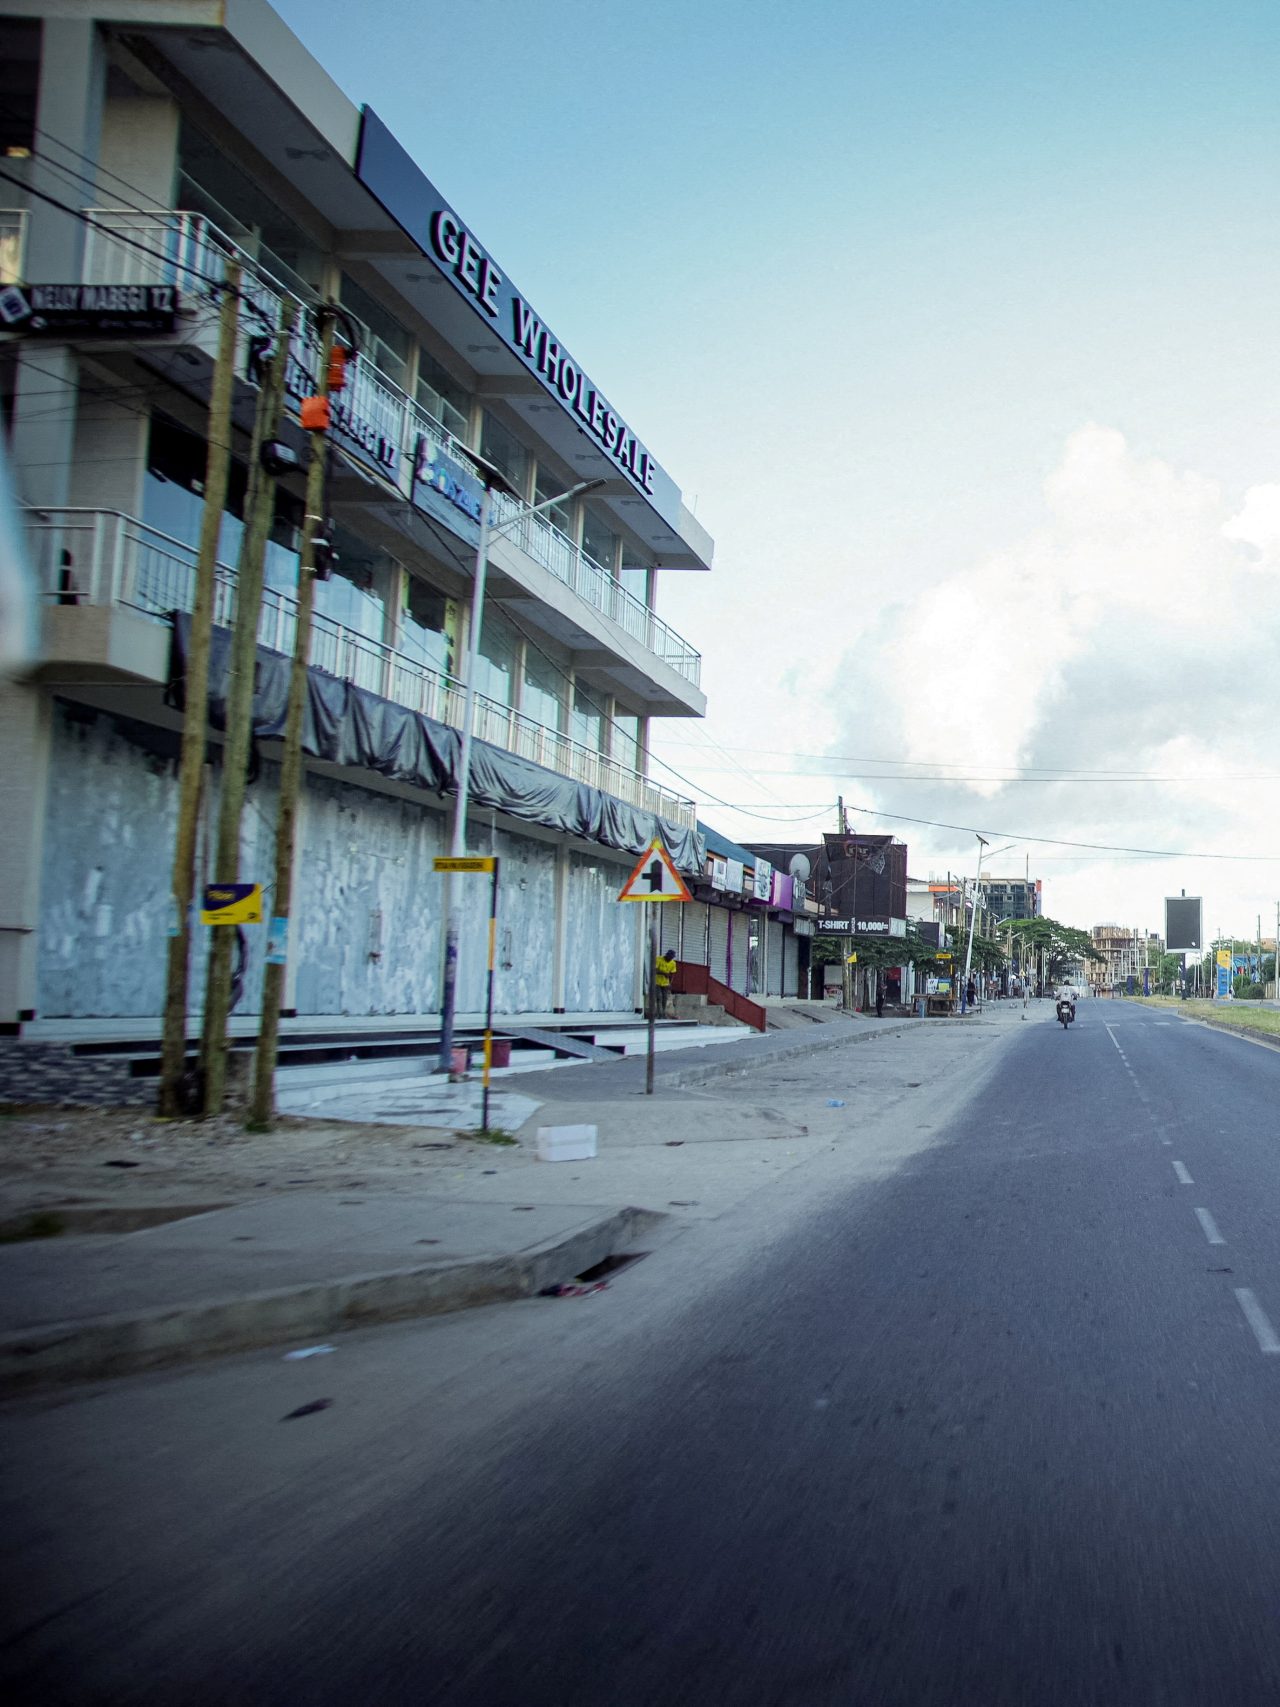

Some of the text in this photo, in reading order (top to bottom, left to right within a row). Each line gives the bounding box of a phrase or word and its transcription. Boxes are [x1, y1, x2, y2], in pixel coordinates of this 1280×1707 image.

[430, 210, 656, 496] GEE WHOLESALE
[818, 919, 850, 930] T-SHIRT
[857, 920, 889, 932] 10,000/=
